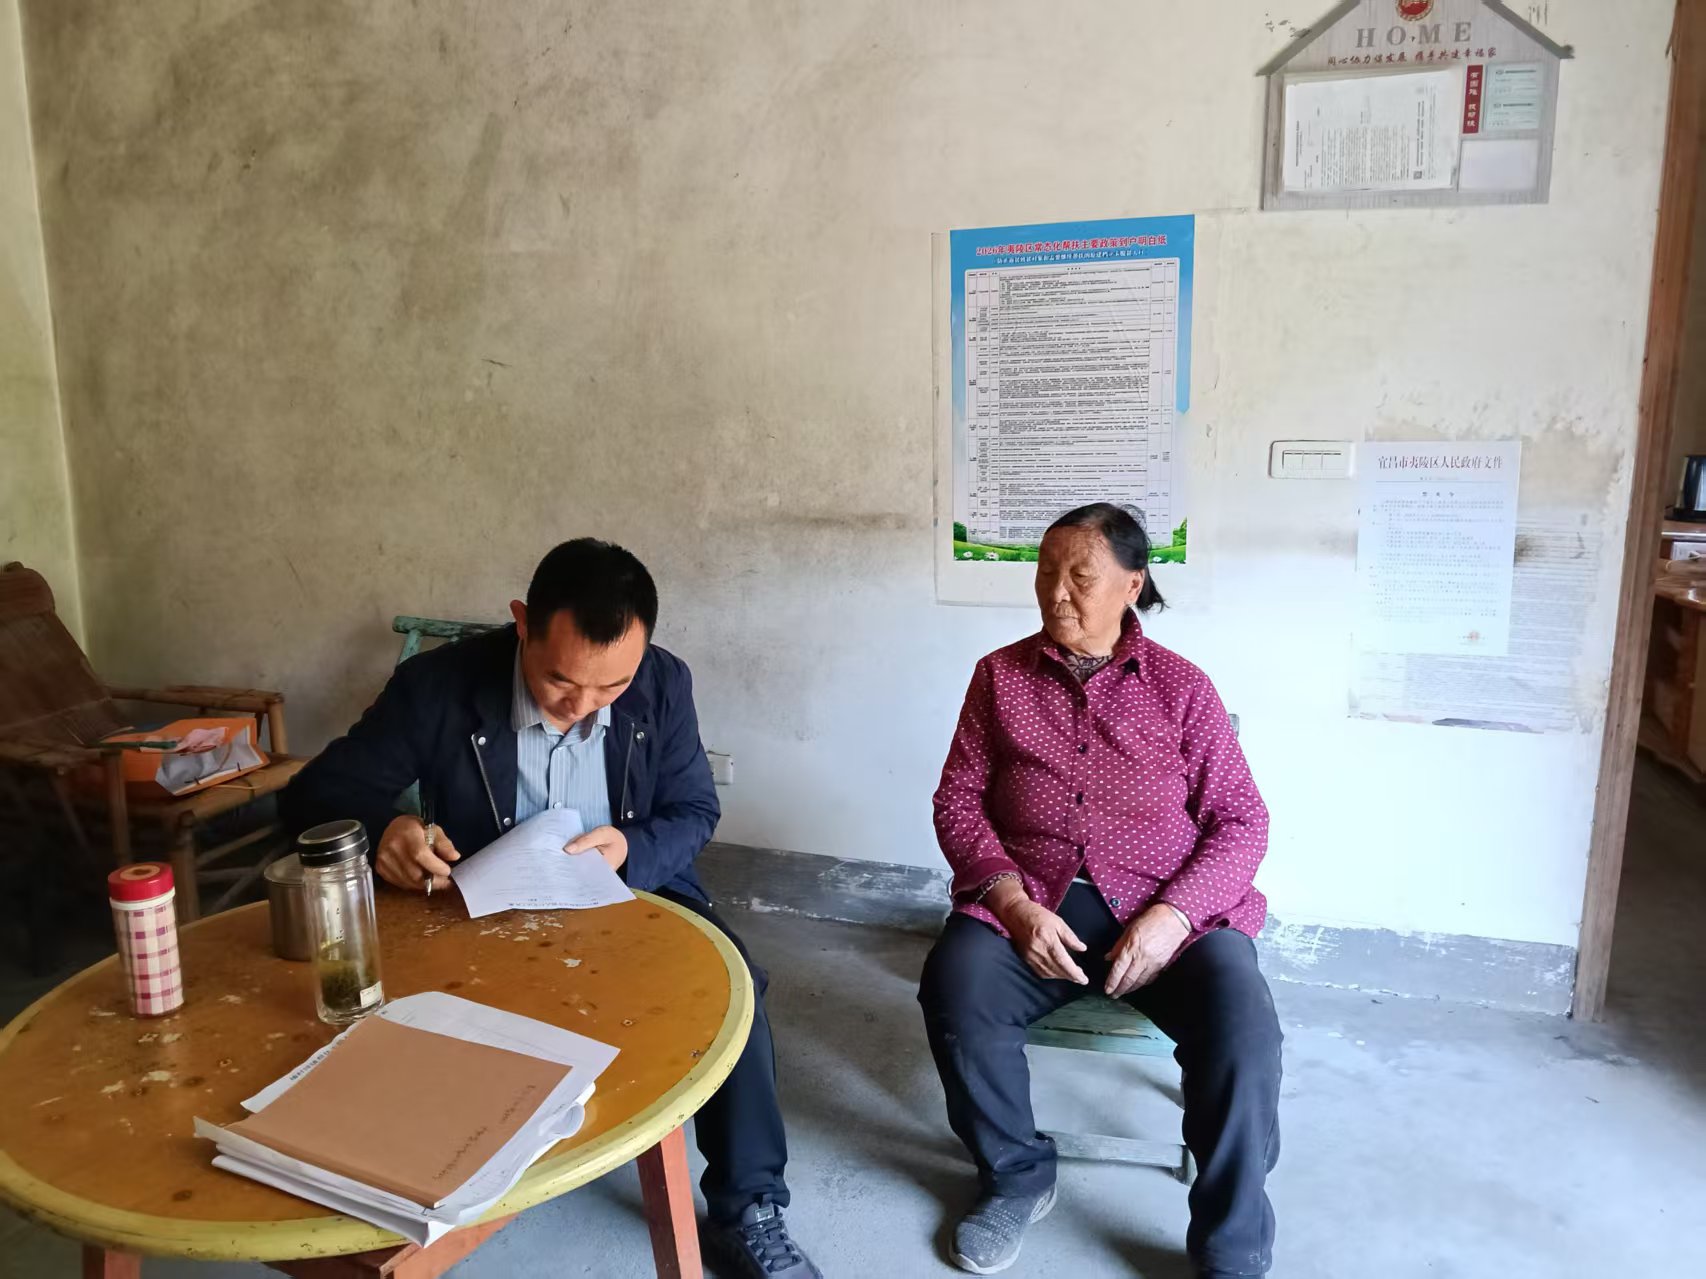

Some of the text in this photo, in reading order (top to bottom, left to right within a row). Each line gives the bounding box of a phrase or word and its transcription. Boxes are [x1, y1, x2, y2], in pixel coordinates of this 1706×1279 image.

[1355, 22, 1472, 49] HOME
[1377, 455, 1503, 469] 宜昌市夷陵区人民政府文件
